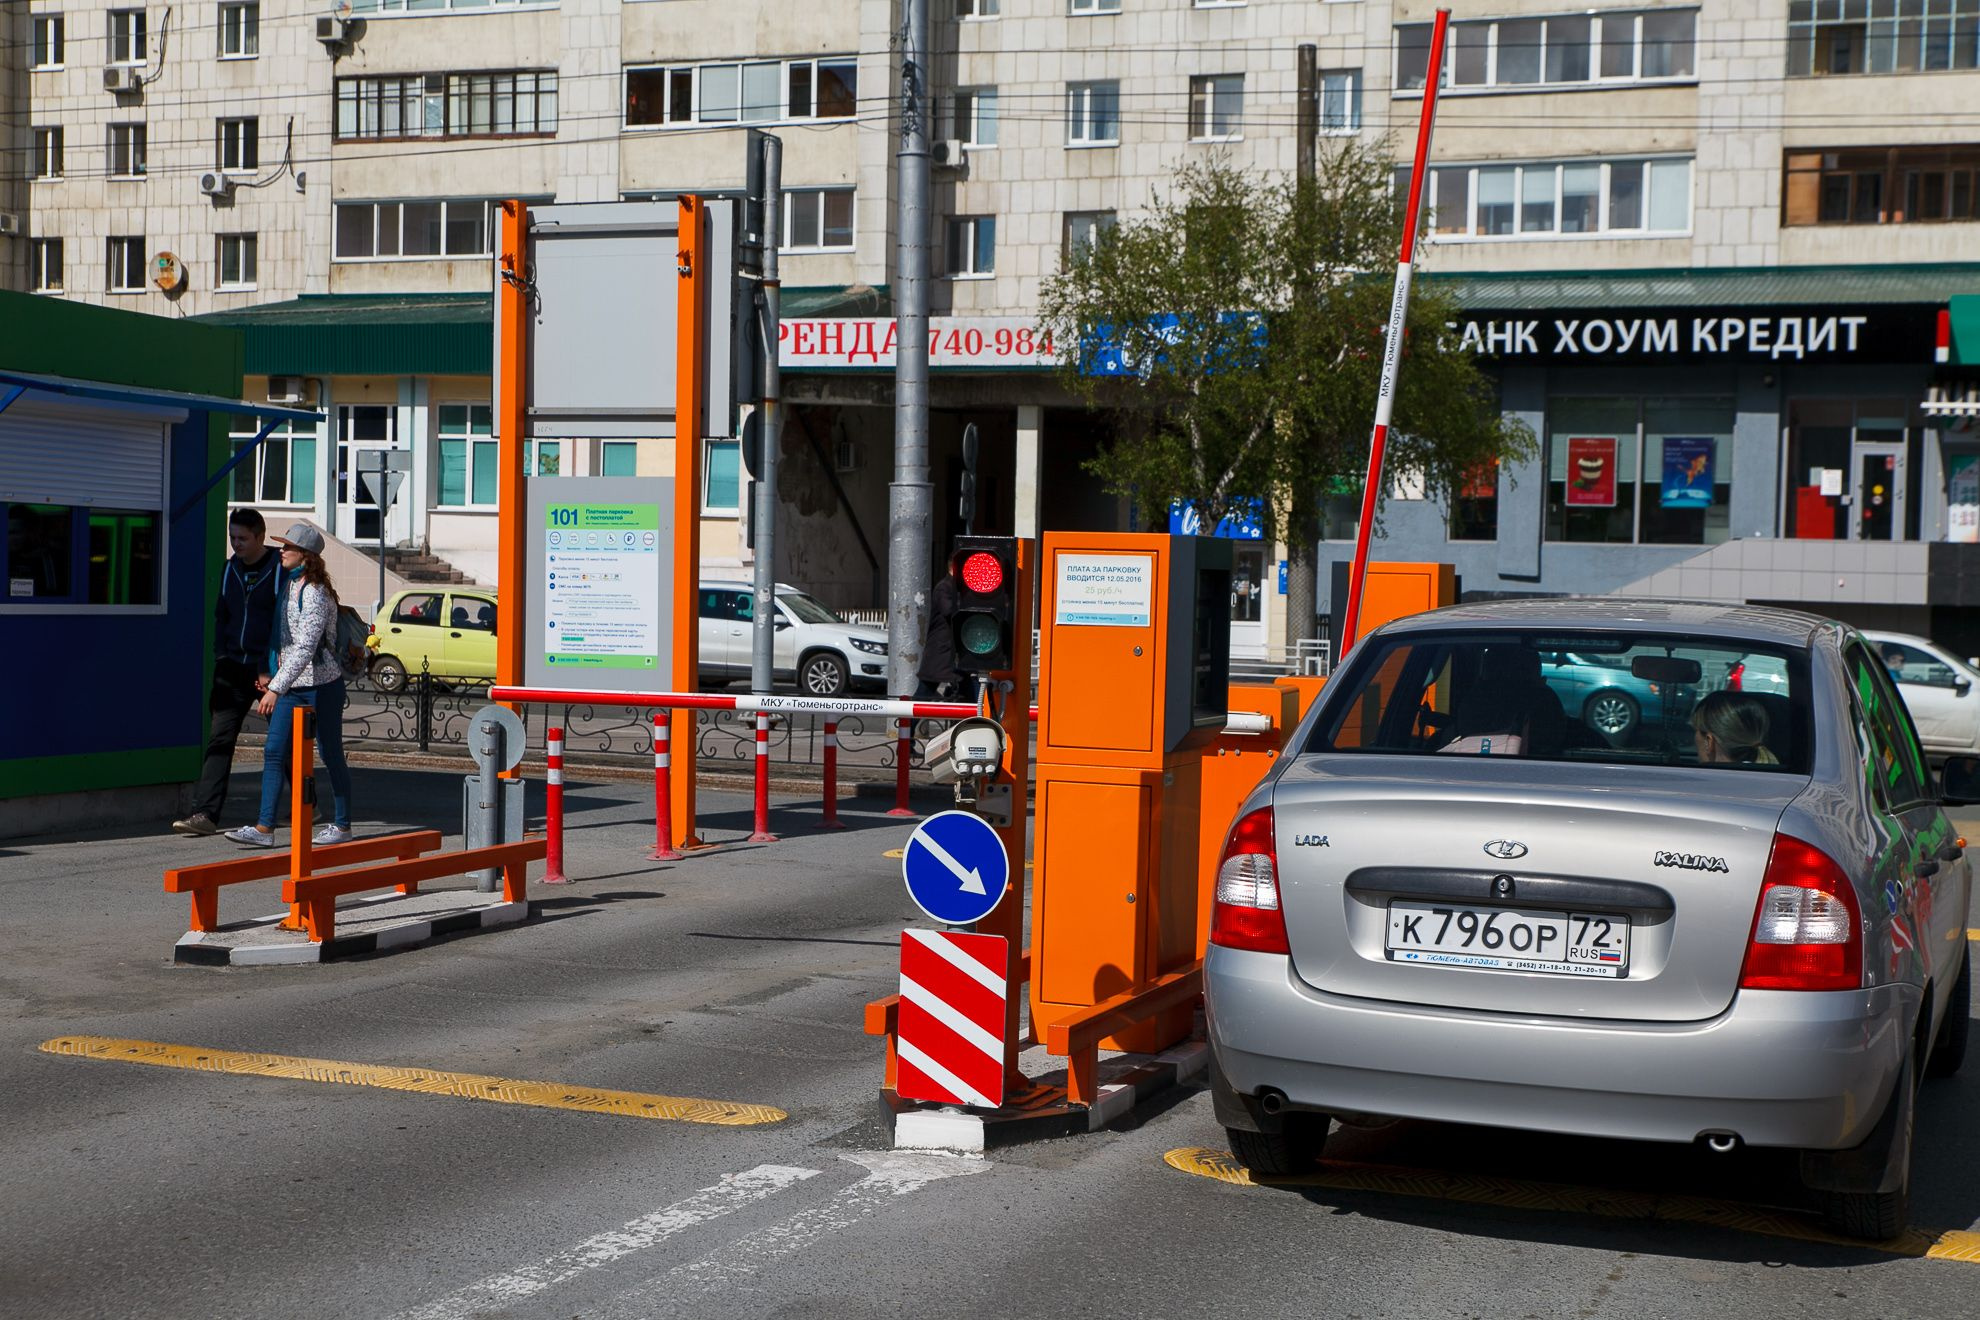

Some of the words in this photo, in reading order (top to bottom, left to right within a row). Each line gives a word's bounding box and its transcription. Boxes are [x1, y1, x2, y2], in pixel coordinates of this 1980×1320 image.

[1553, 318, 1679, 354] ХОУМ
[1692, 316, 1867, 359] КРЕДИТ
[1381, 375, 1391, 397] МКУ
[550, 508, 579, 526] 101
[1103, 566, 1142, 574] ПАРКОВКУ
[1107, 575, 1142, 583] 12.05.2016
[1085, 586, 1095, 594] 25
[760, 698, 785, 707] МКУ
[786, 699, 884, 712] «Тюменьгортранс»
[1295, 834, 1330, 848] LADA
[1653, 850, 1730, 874] KALINA
[1402, 907, 1558, 953] К796ОР
[1572, 915, 1612, 948] 72
[1569, 947, 1599, 960] RUS
[1516, 961, 1537, 970] (3452)
